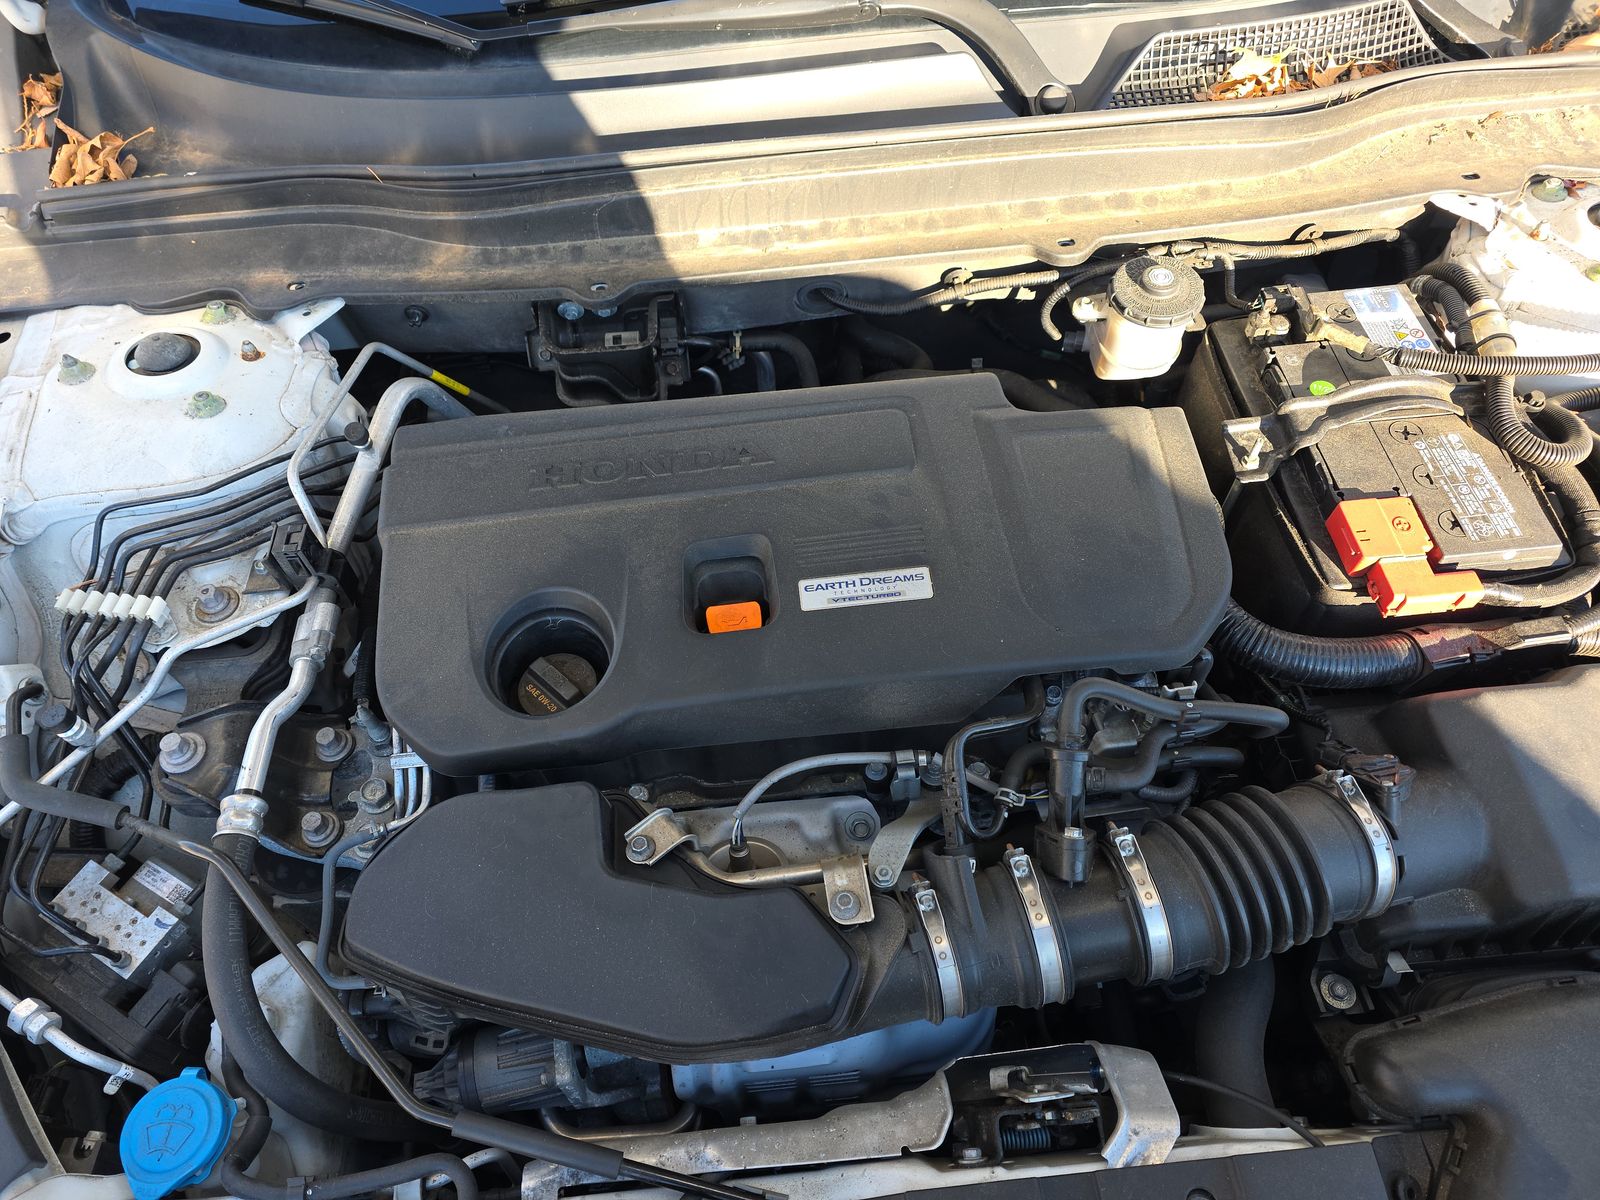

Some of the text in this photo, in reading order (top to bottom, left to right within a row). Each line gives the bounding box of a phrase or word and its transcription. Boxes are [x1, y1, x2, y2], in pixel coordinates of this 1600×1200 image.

[528, 447, 777, 492] HONDA
[804, 573, 925, 593] EARTH DREAMS
[833, 585, 898, 596] TECHNOLOGY
[526, 683, 558, 712] SAE 0W-20
